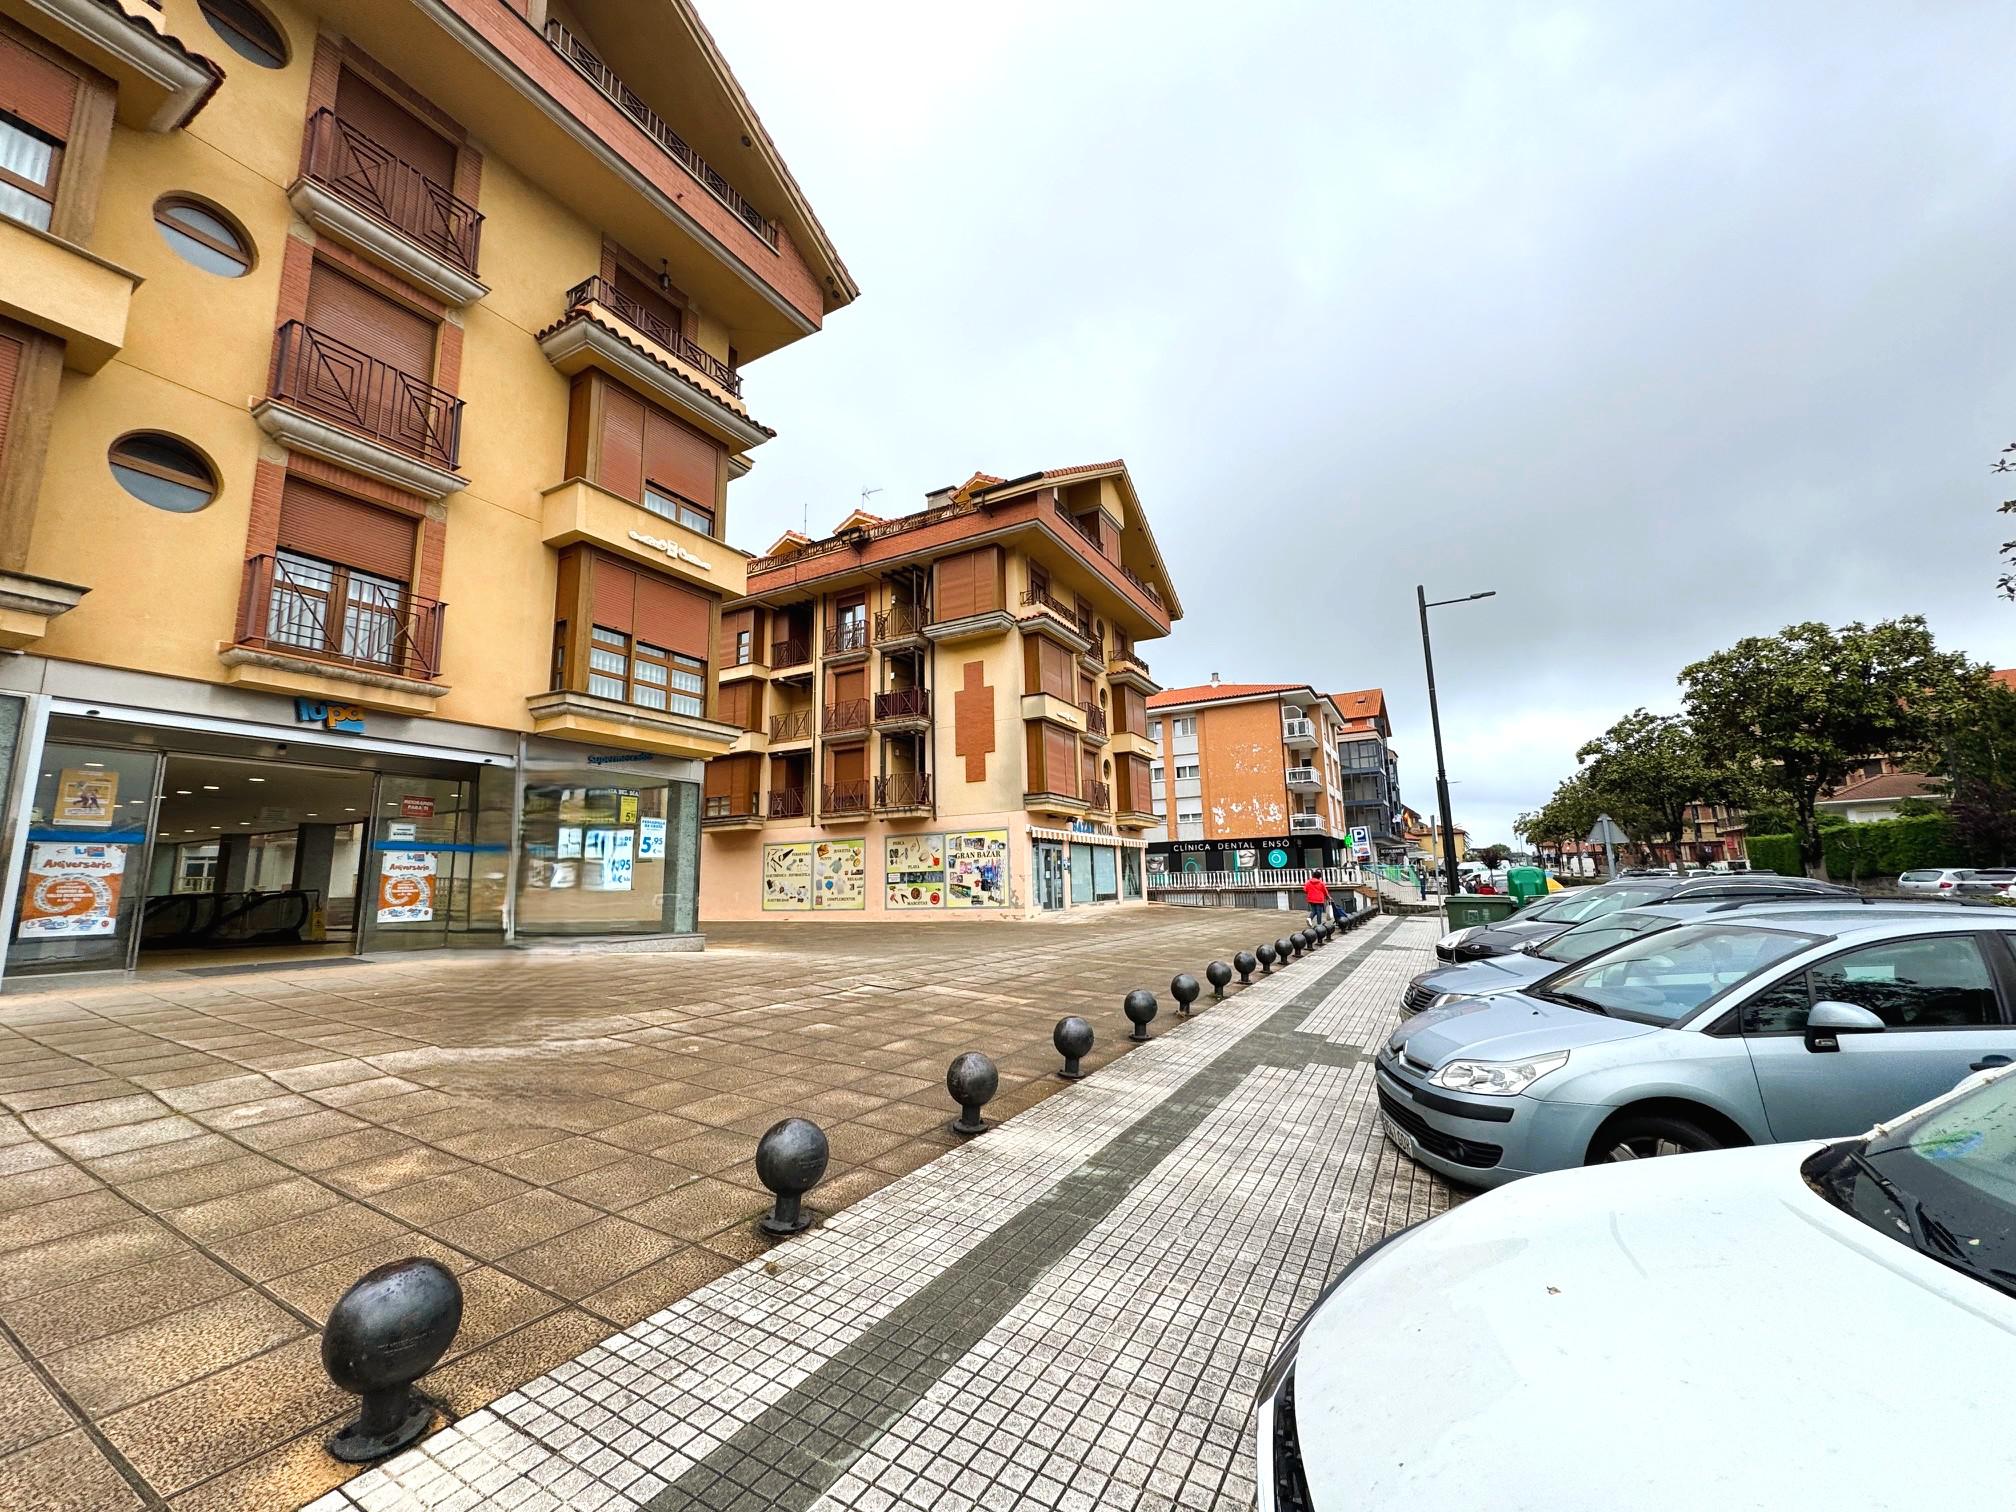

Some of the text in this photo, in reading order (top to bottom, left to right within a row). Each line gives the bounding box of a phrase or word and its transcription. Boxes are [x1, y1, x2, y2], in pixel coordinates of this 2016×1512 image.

[299, 698, 368, 728] lupa
[1354, 829, 1365, 842] P
[1173, 843, 1211, 852] CLÍNICA
[1217, 841, 1255, 850] DENTAL
[955, 850, 1001, 860] GRAN BAZAR
[43, 858, 113, 869] Aniversario
